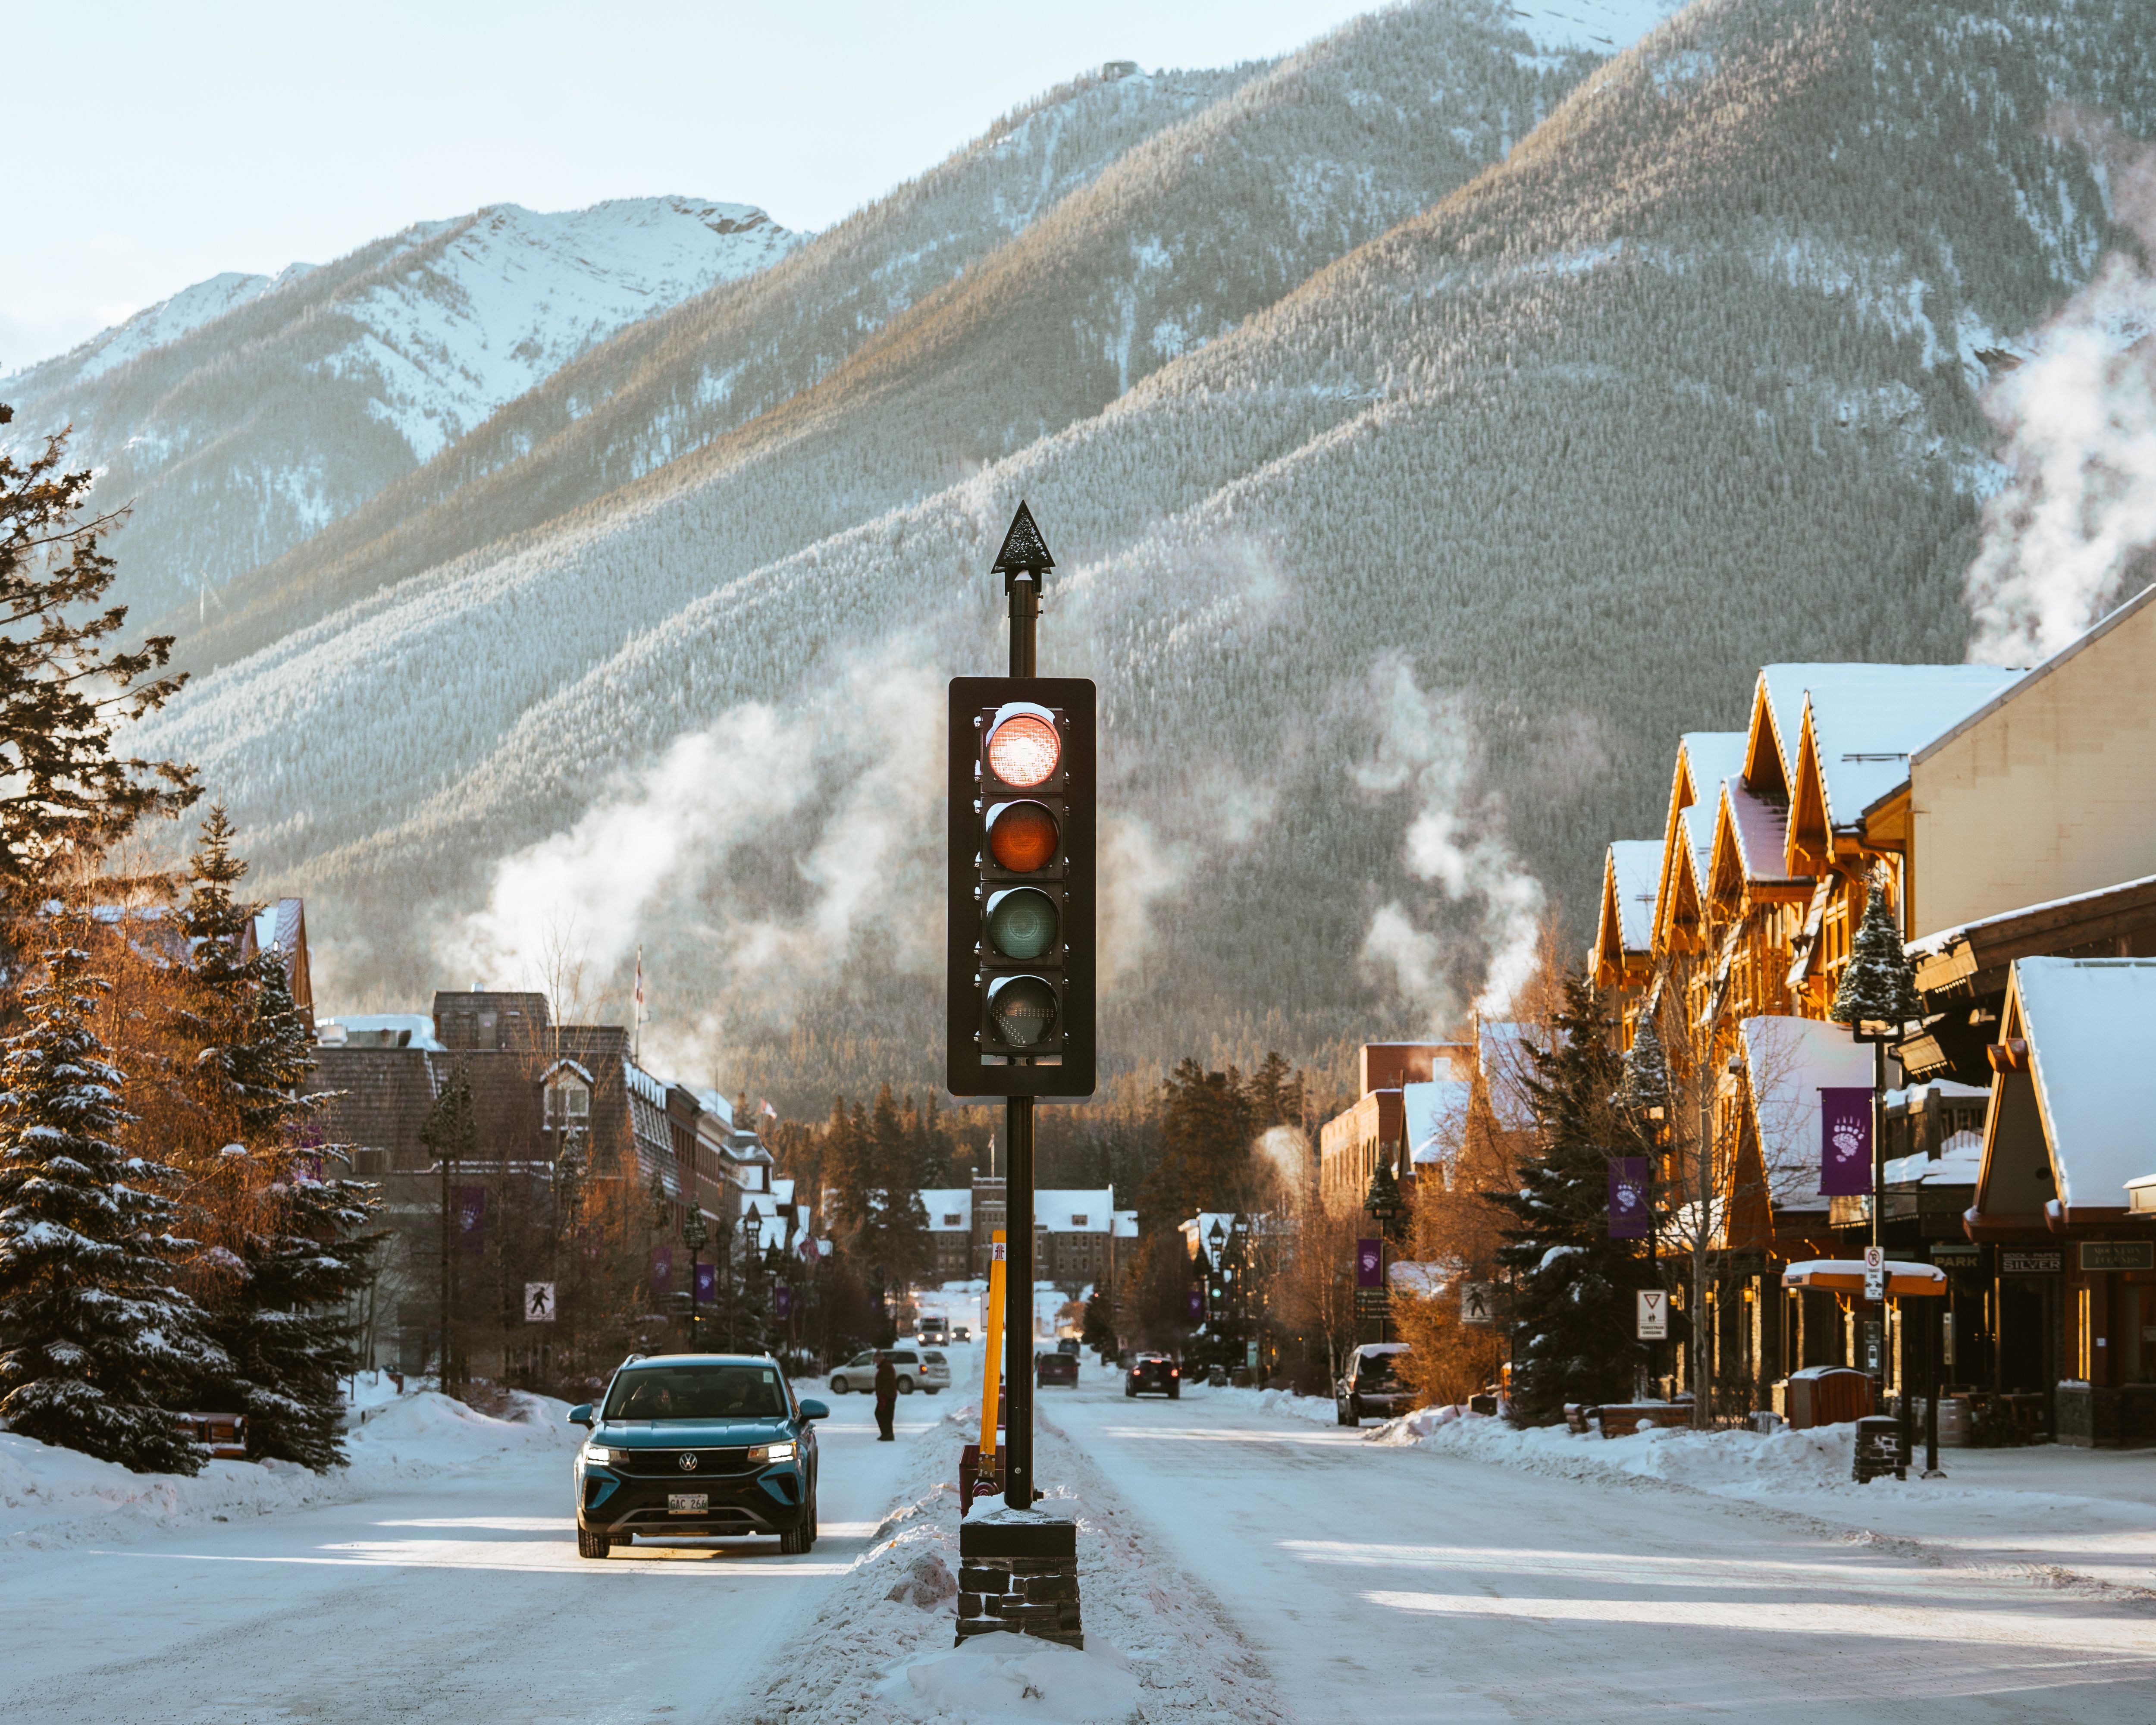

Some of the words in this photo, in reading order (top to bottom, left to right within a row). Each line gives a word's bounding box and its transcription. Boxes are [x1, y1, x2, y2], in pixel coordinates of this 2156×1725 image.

[1934, 1256, 1977, 1267] PARK
[2003, 1260, 2061, 1269] SILVER
[671, 1499, 686, 1509] GAC
[691, 1499, 707, 1509] 266
